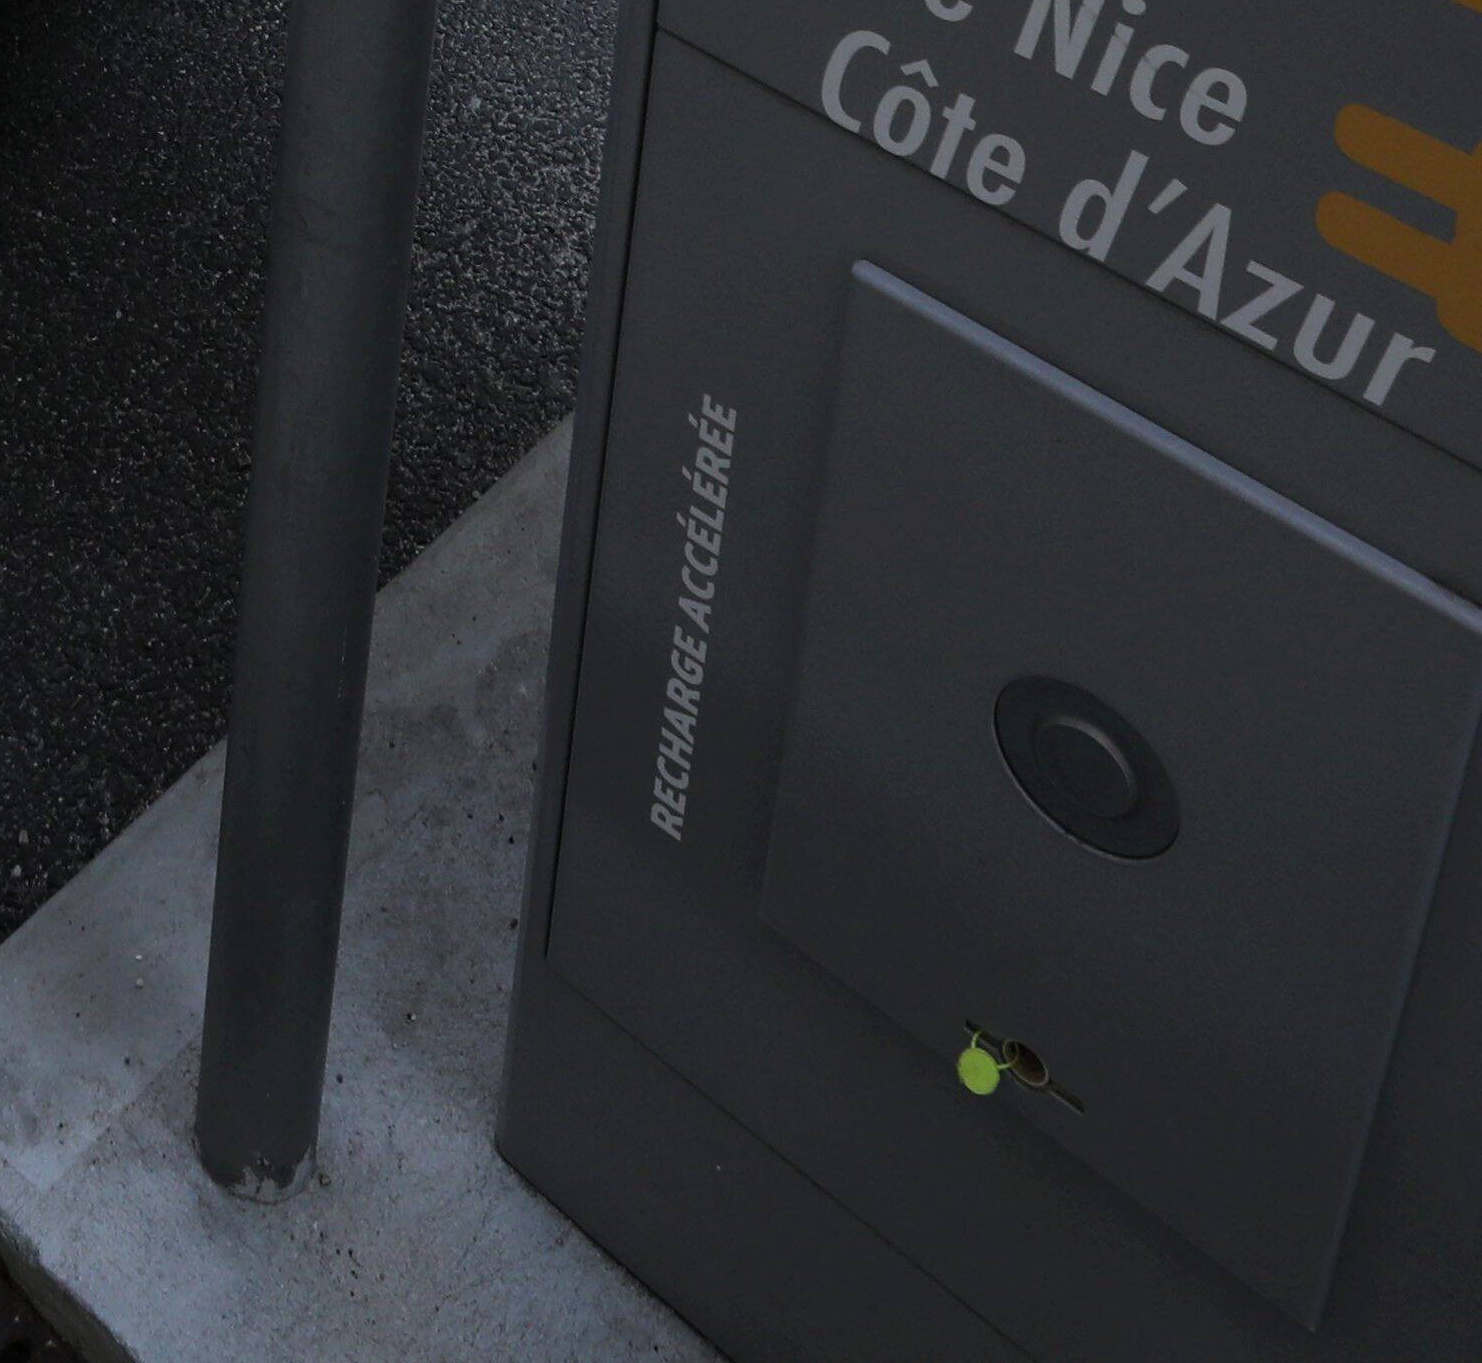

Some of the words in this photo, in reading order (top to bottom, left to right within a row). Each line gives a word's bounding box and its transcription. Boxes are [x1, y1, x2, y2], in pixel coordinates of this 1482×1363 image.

[821, 29, 1027, 207] Côte
[1057, 149, 1437, 409] d'Azur
[676, 393, 738, 635] ACCÉLÉRÉE
[649, 624, 709, 842] RECHARGE
